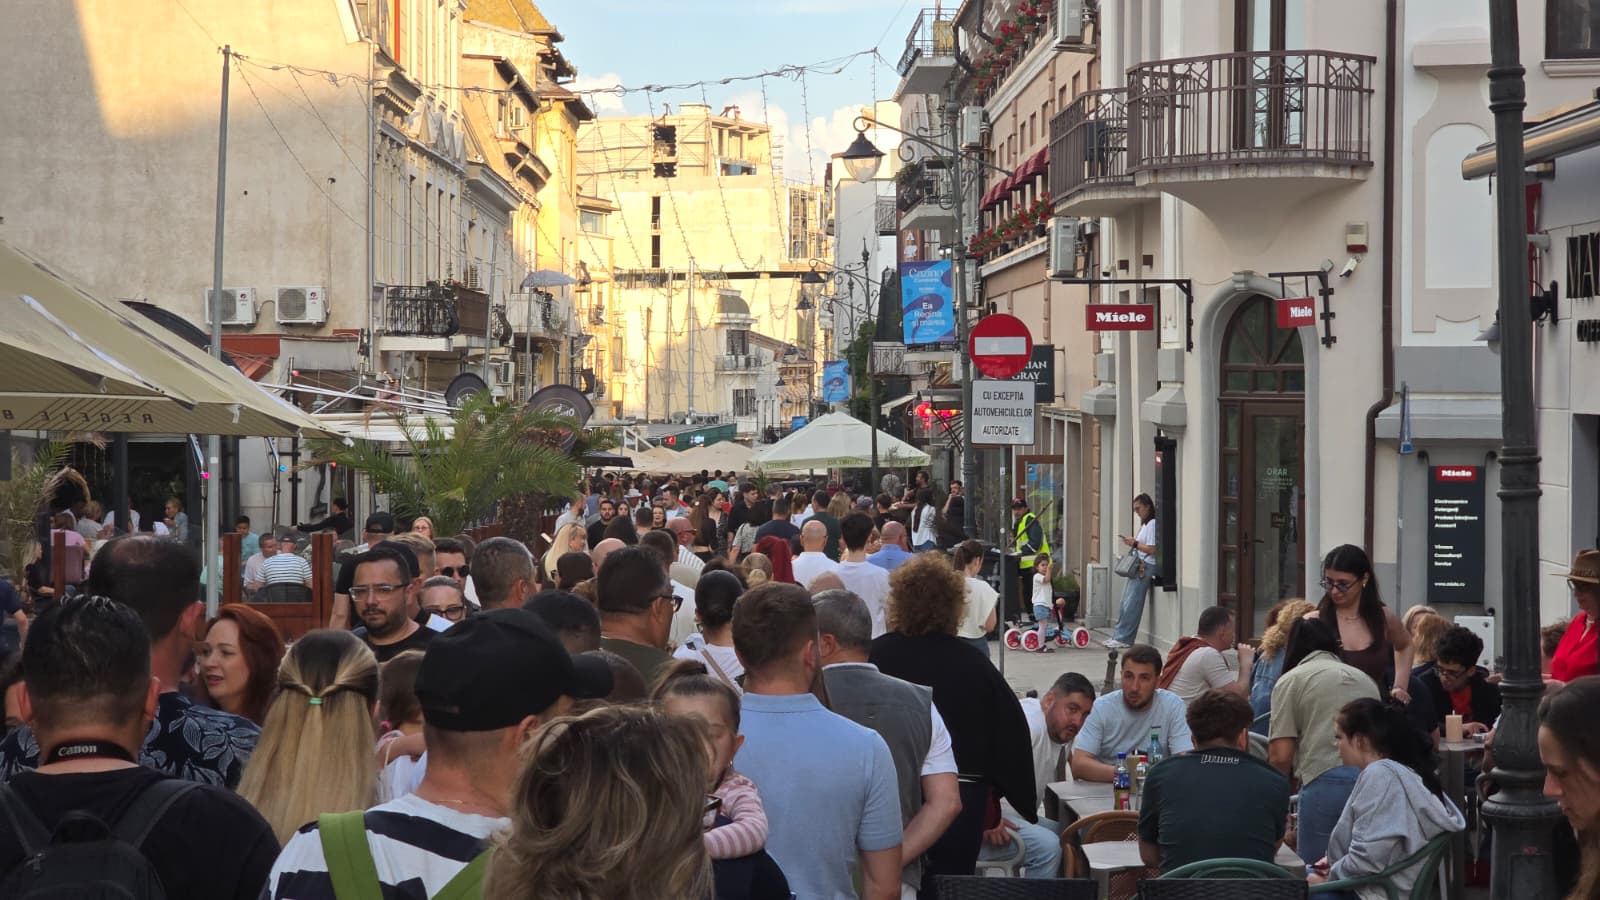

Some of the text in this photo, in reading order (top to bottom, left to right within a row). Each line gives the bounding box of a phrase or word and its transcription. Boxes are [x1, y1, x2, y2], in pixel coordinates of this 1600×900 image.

[1095, 311, 1146, 323] Miele
[1290, 306, 1312, 318] Miele
[982, 391, 1024, 401] CU EXCEPTIA
[973, 407, 1033, 418] AUTOVEHICULELOR
[983, 426, 1020, 435] AUTORIZATE
[57, 744, 97, 757] Canon
